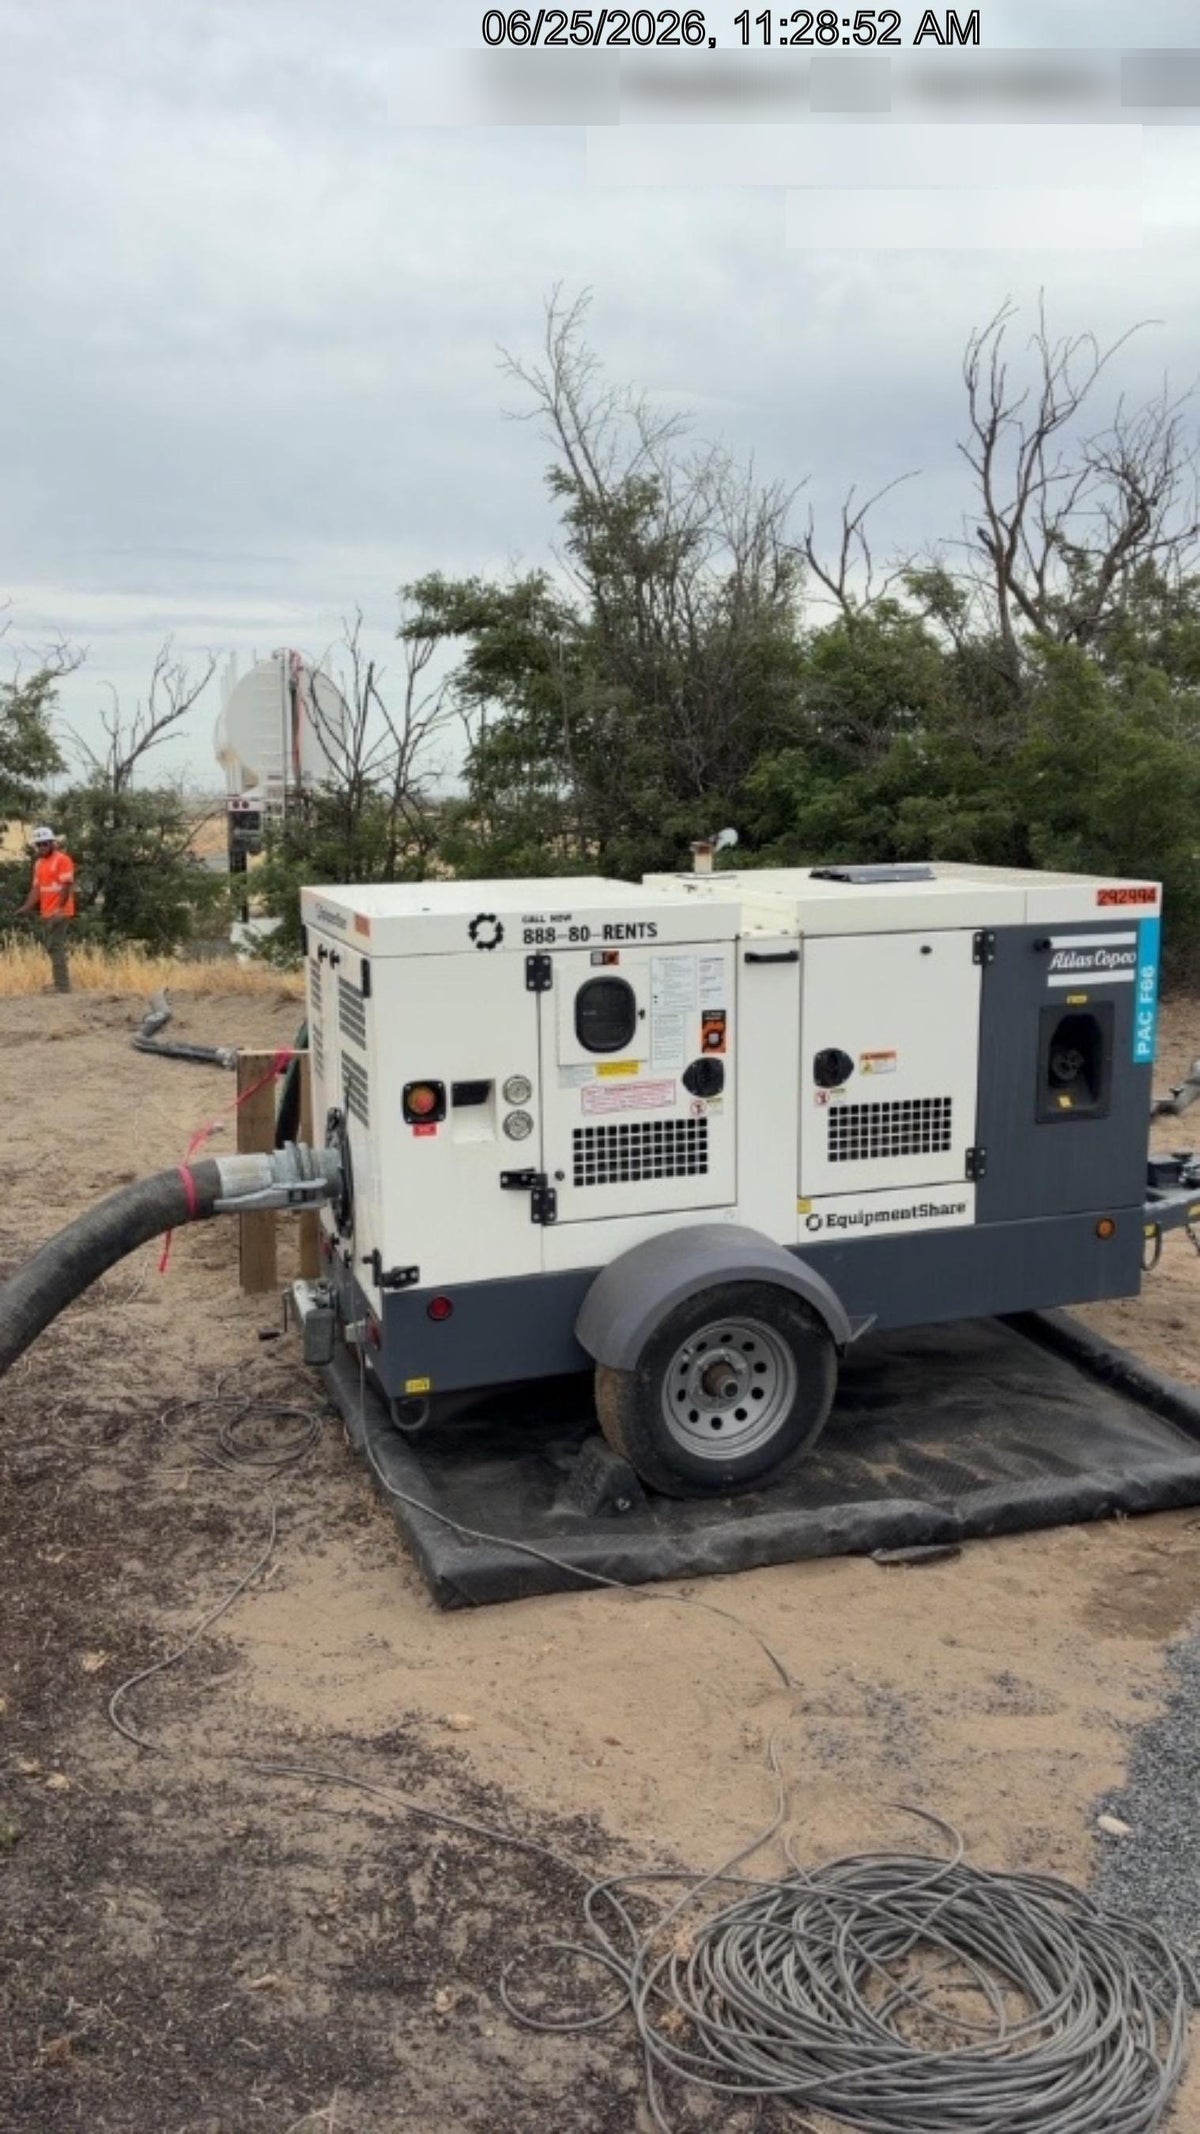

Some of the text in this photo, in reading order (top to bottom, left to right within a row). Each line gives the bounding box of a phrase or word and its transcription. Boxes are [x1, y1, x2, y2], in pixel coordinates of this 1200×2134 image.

[521, 914, 546, 924] CALL
[522, 922, 658, 945] 888-80-RENTS
[1049, 949, 1137, 970] Atlas Copco
[1137, 1011, 1154, 1056] PAC
[826, 1202, 967, 1229] EquipmentShare
